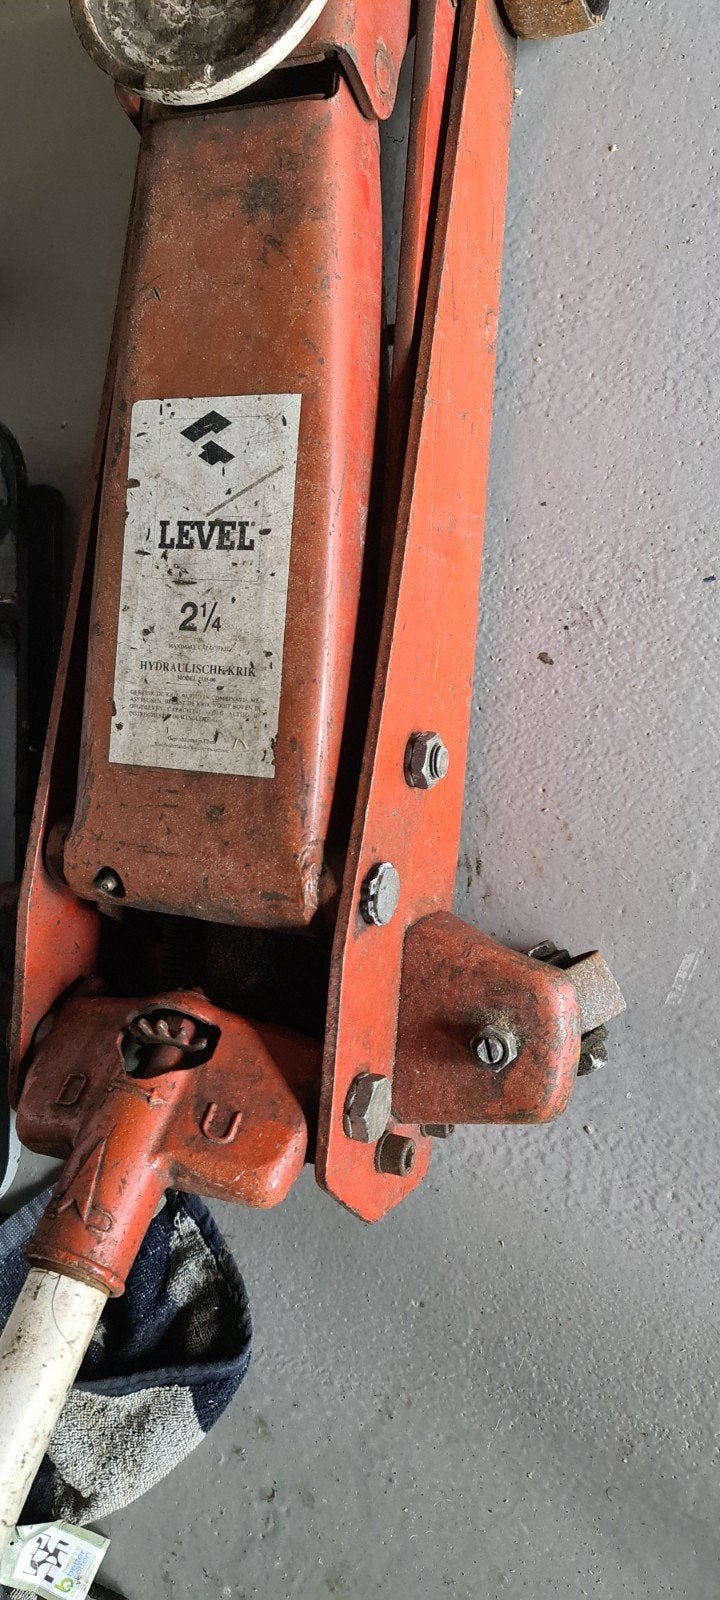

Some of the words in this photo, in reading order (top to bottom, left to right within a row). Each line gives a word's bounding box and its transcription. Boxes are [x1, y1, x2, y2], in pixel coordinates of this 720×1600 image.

[158, 520, 255, 551] LEVEL
[140, 661, 226, 676] HYDRAULISCHE
[227, 664, 256, 678] KRIK
[202, 1101, 243, 1144] U
